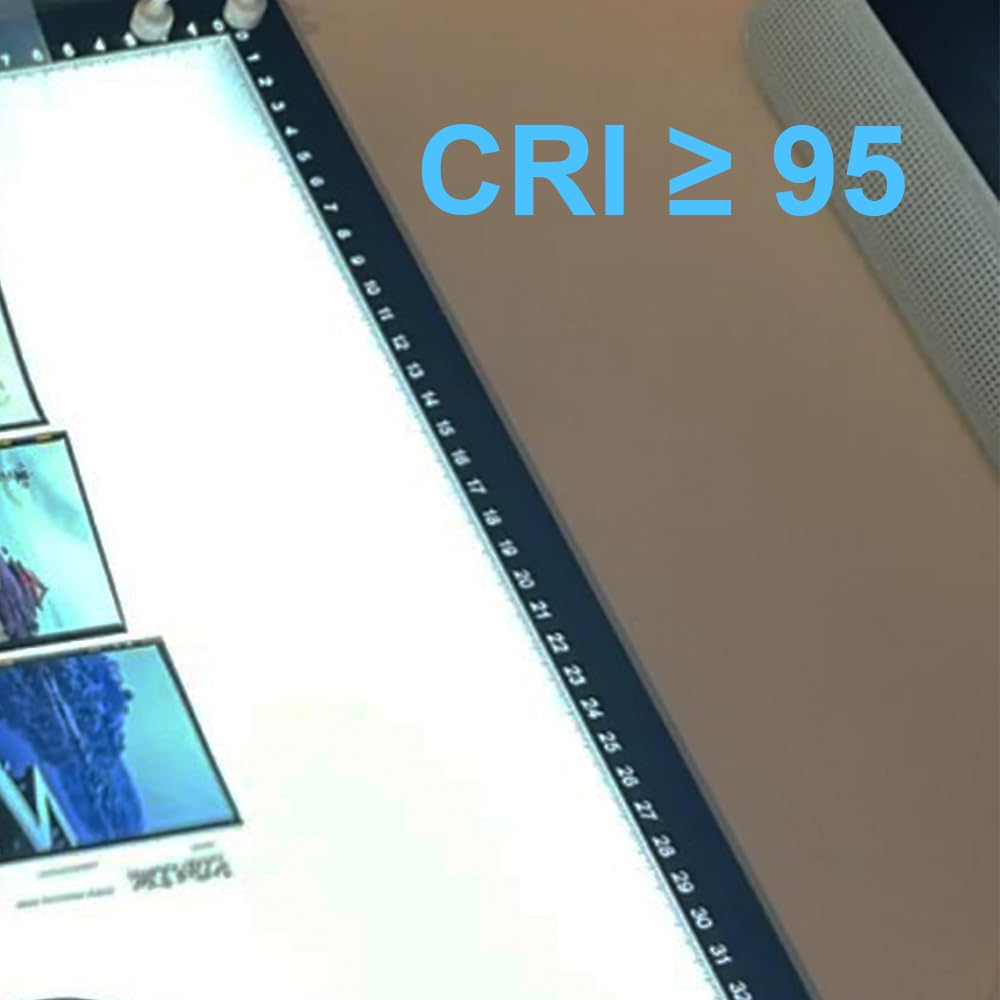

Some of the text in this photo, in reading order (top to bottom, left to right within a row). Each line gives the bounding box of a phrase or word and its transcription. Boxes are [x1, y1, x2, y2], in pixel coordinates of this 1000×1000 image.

[0, 53, 11, 68] 7
[234, 30, 251, 42] 0
[246, 52, 261, 62] 1
[257, 75, 274, 87] 2
[309, 176, 325, 188] 6
[323, 202, 339, 212] 7
[349, 254, 366, 266] 9
[363, 279, 382, 296] 10
[377, 306, 395, 321] 11
[391, 334, 411, 351] 12
[405, 362, 425, 380] 13
[420, 390, 440, 408] 14
[435, 419, 456, 437] 15
[451, 448, 471, 467] 16
[466, 478, 487, 494] 17
[482, 508, 503, 527] 18
[498, 538, 519, 557] 19
[512, 569, 536, 590] 20
[529, 600, 553, 620] 21
[545, 632, 570, 654] 22
[562, 664, 587, 687] 23
[579, 697, 605, 720] 24
[596, 731, 622, 754] 25
[615, 765, 640, 788] 26
[633, 799, 659, 821] 27
[651, 834, 677, 859] 28
[669, 870, 695, 894] 29
[689, 906, 714, 930] 30
[708, 943, 732, 966] 31
